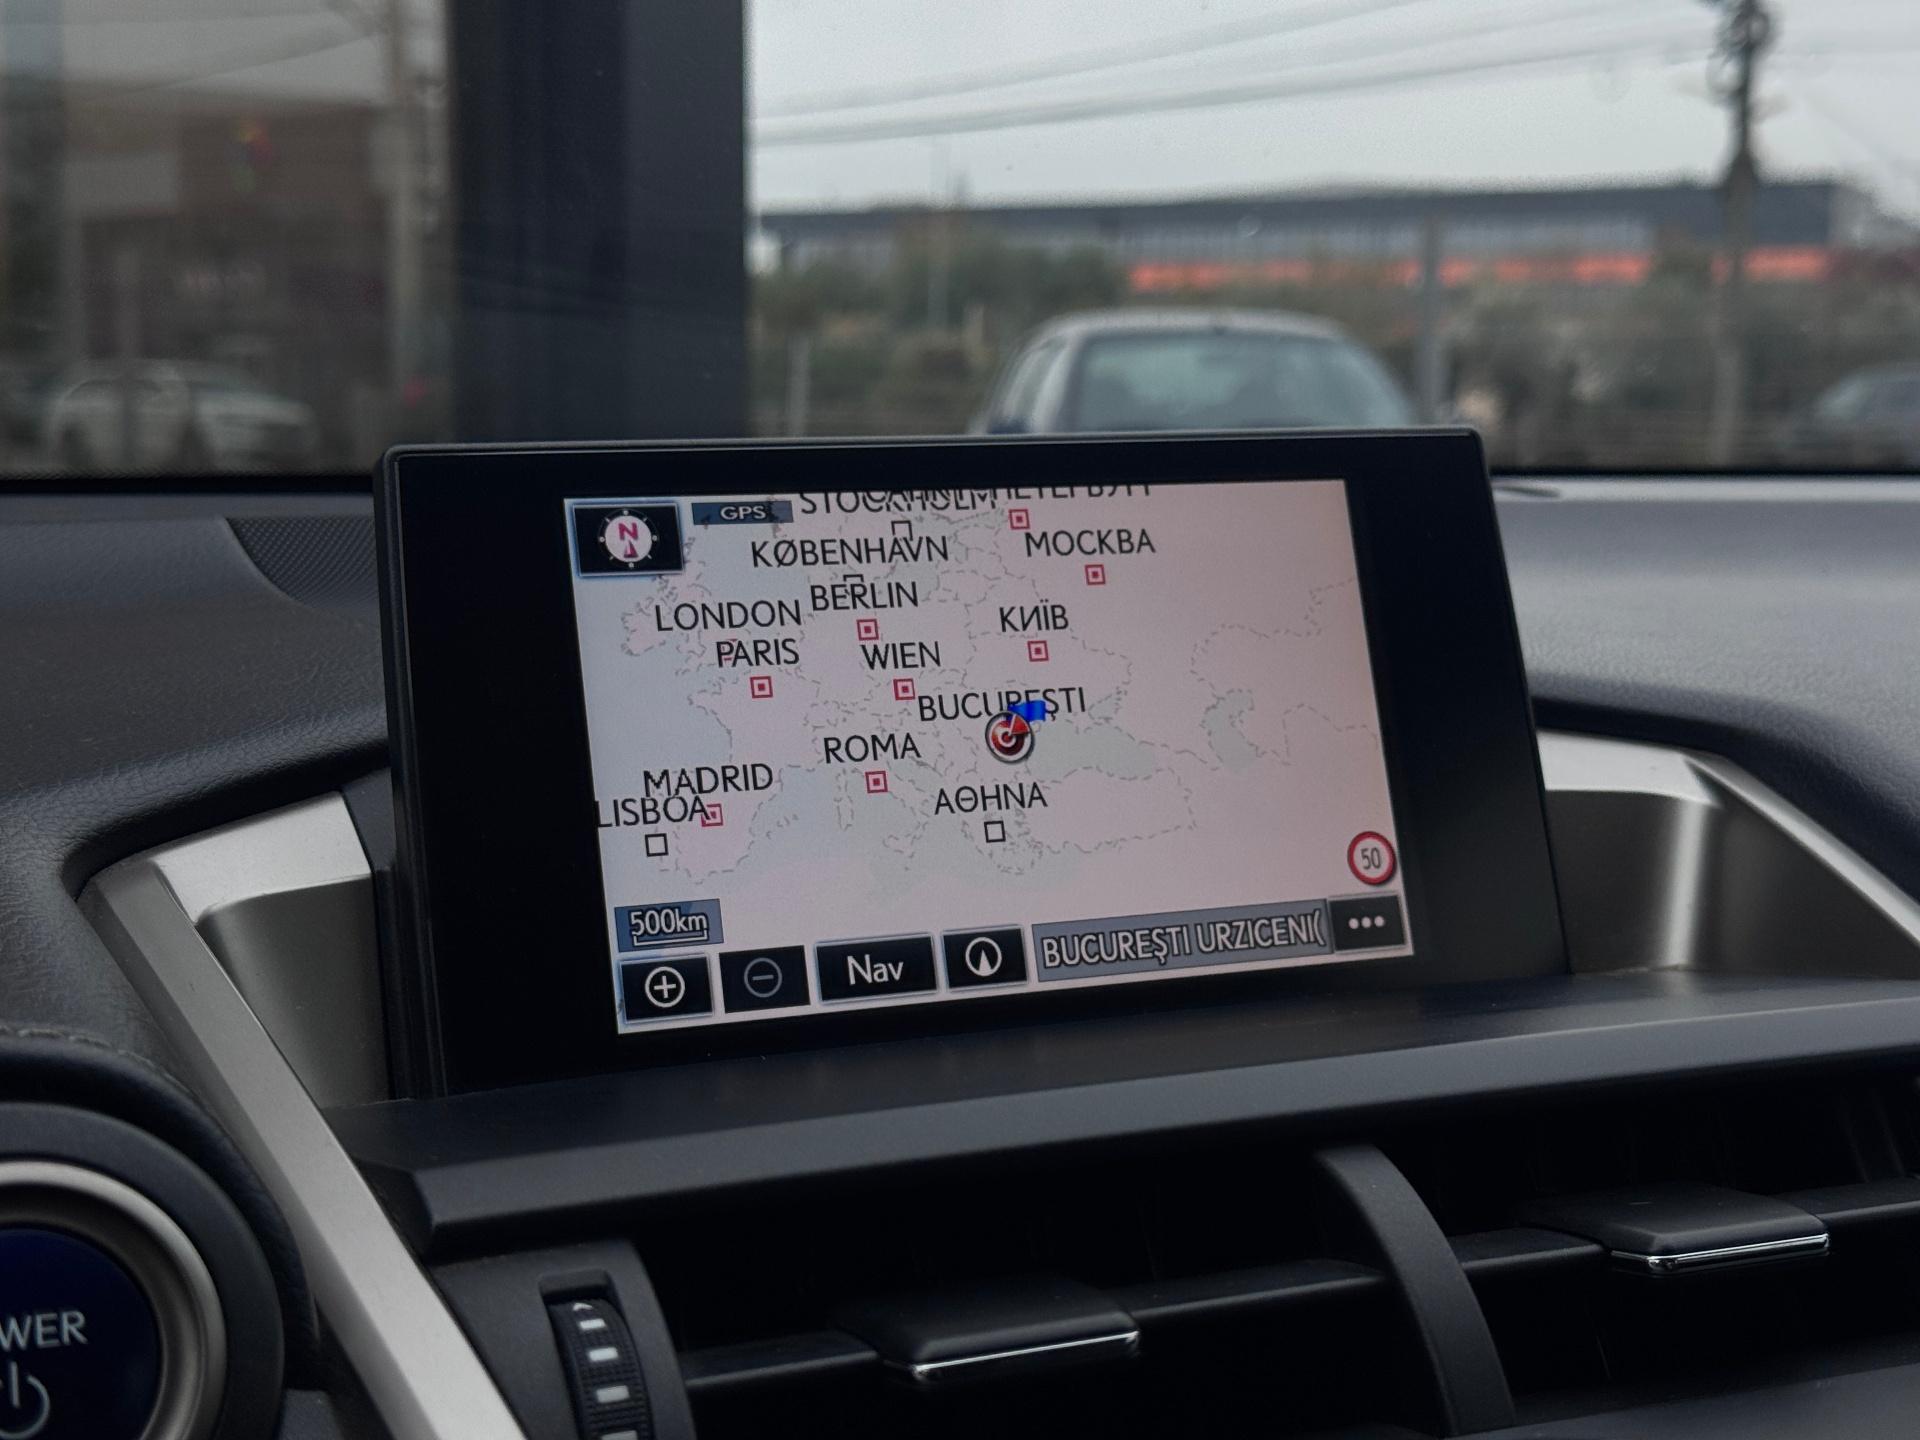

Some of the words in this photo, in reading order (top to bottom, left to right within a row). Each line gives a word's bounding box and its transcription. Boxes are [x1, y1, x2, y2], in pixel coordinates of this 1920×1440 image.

[720, 506, 766, 520] GPS
[618, 523, 637, 540] N
[1025, 529, 1156, 557] МОСКВА
[752, 536, 949, 567] KØBENHAVN
[810, 582, 918, 612] BERLIN
[656, 600, 802, 632] LONDON
[1000, 600, 1069, 633] КИЇВ
[716, 639, 800, 667] PARIS
[861, 641, 941, 669] WIEN
[823, 733, 922, 764] ROMA
[644, 763, 774, 797] MADRID
[595, 795, 710, 828] LISBOA
[934, 782, 1048, 815] ΑΘΗΝΑ
[1360, 848, 1382, 870] 50
[629, 908, 708, 936] 500km
[847, 954, 904, 985] Nav
